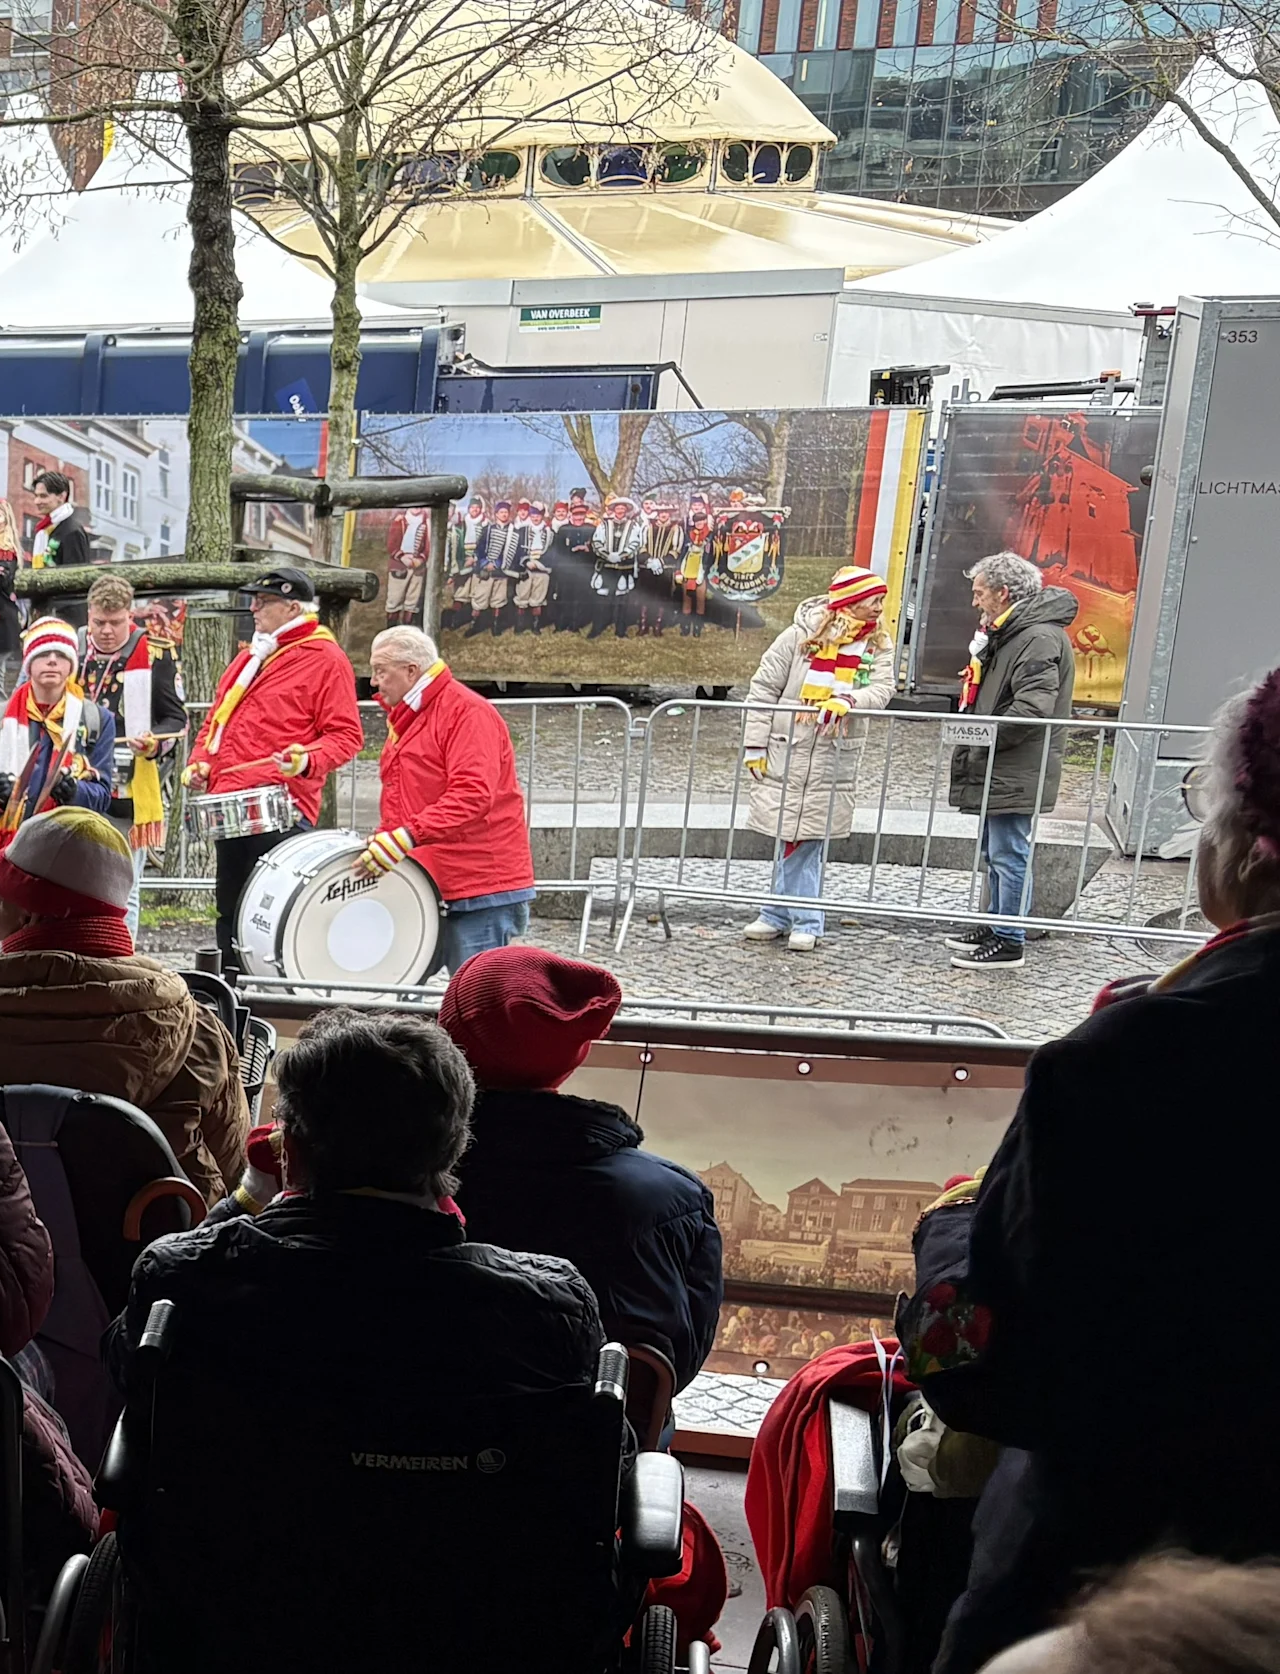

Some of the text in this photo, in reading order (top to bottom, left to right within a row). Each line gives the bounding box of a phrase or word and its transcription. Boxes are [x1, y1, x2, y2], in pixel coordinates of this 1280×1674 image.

[530, 308, 591, 320] VAN OVERBEEK
[1227, 330, 1258, 343] 353
[1199, 481, 1280, 495] LICHTMA
[350, 1452, 469, 1472] VERMEIREN
